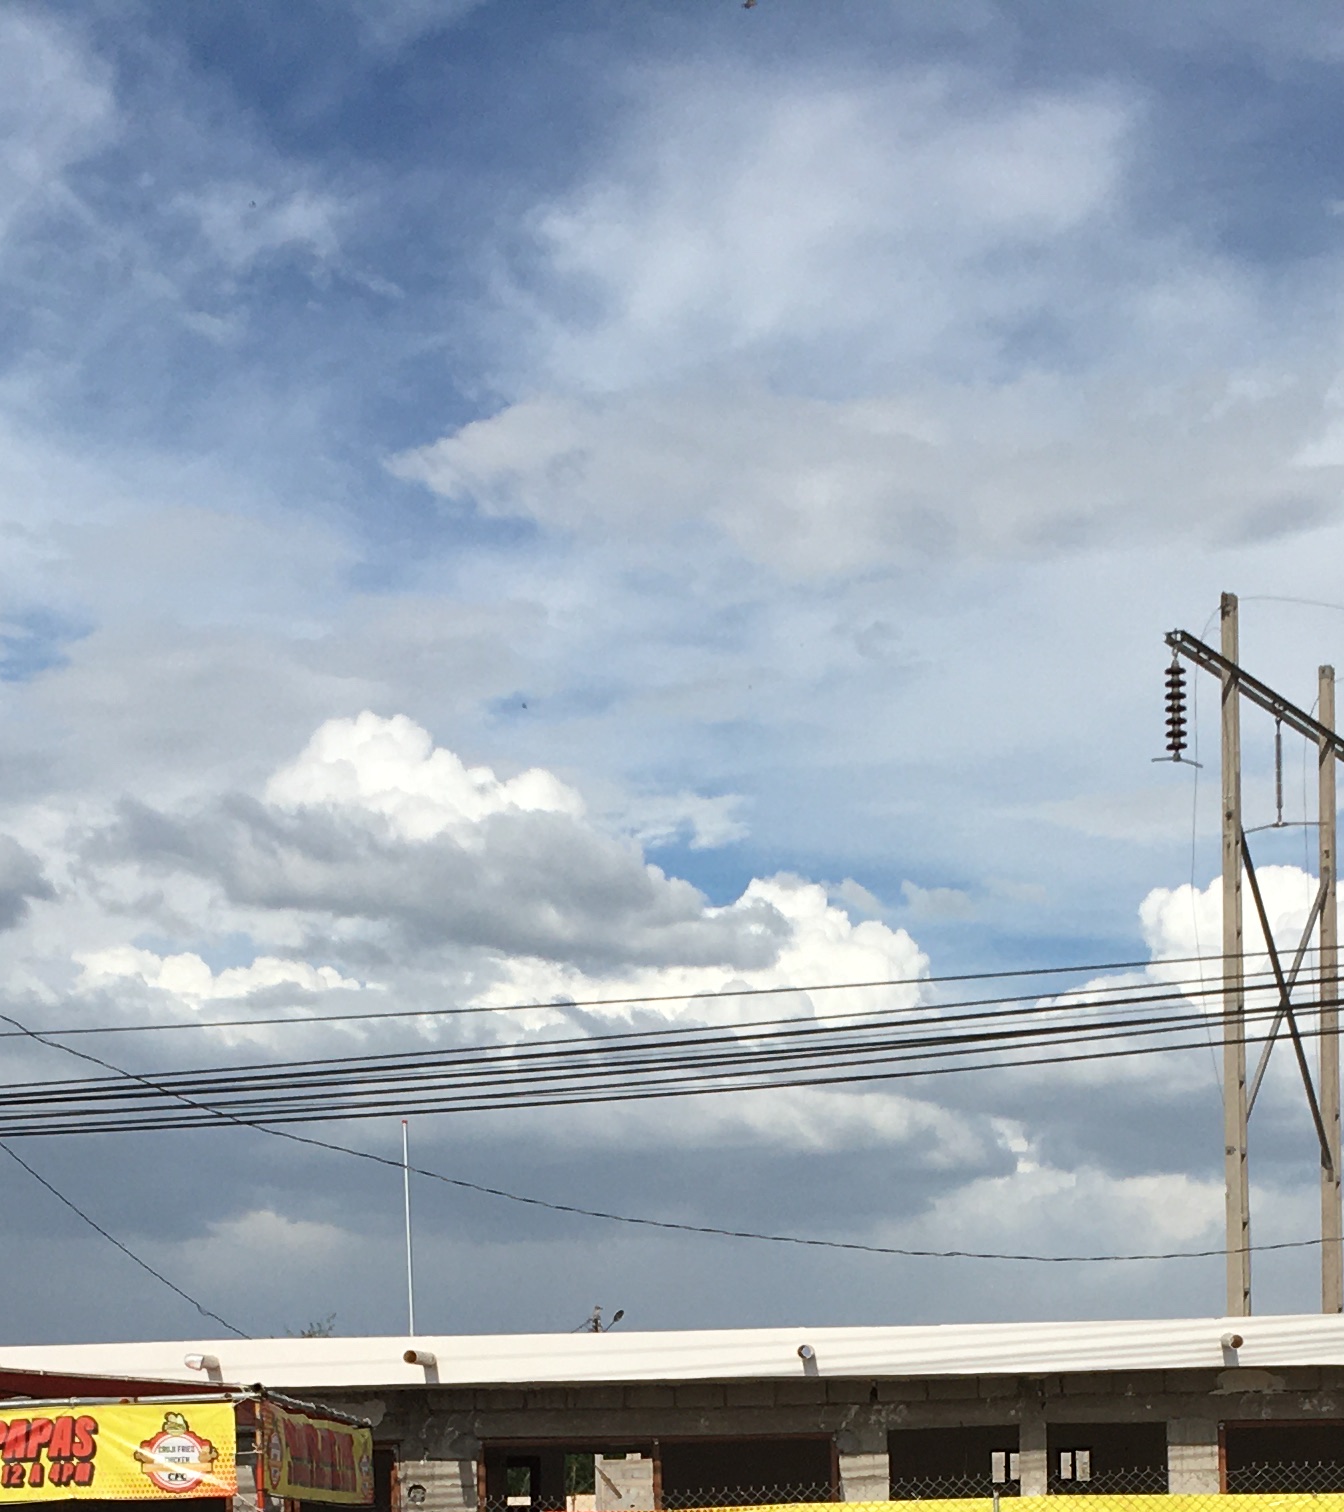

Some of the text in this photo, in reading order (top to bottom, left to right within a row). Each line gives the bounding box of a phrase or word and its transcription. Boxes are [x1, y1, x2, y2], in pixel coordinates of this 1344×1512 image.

[1, 1462, 25, 1488] 12
[29, 1462, 44, 1488] A
[48, 1460, 95, 1488] 4PM
